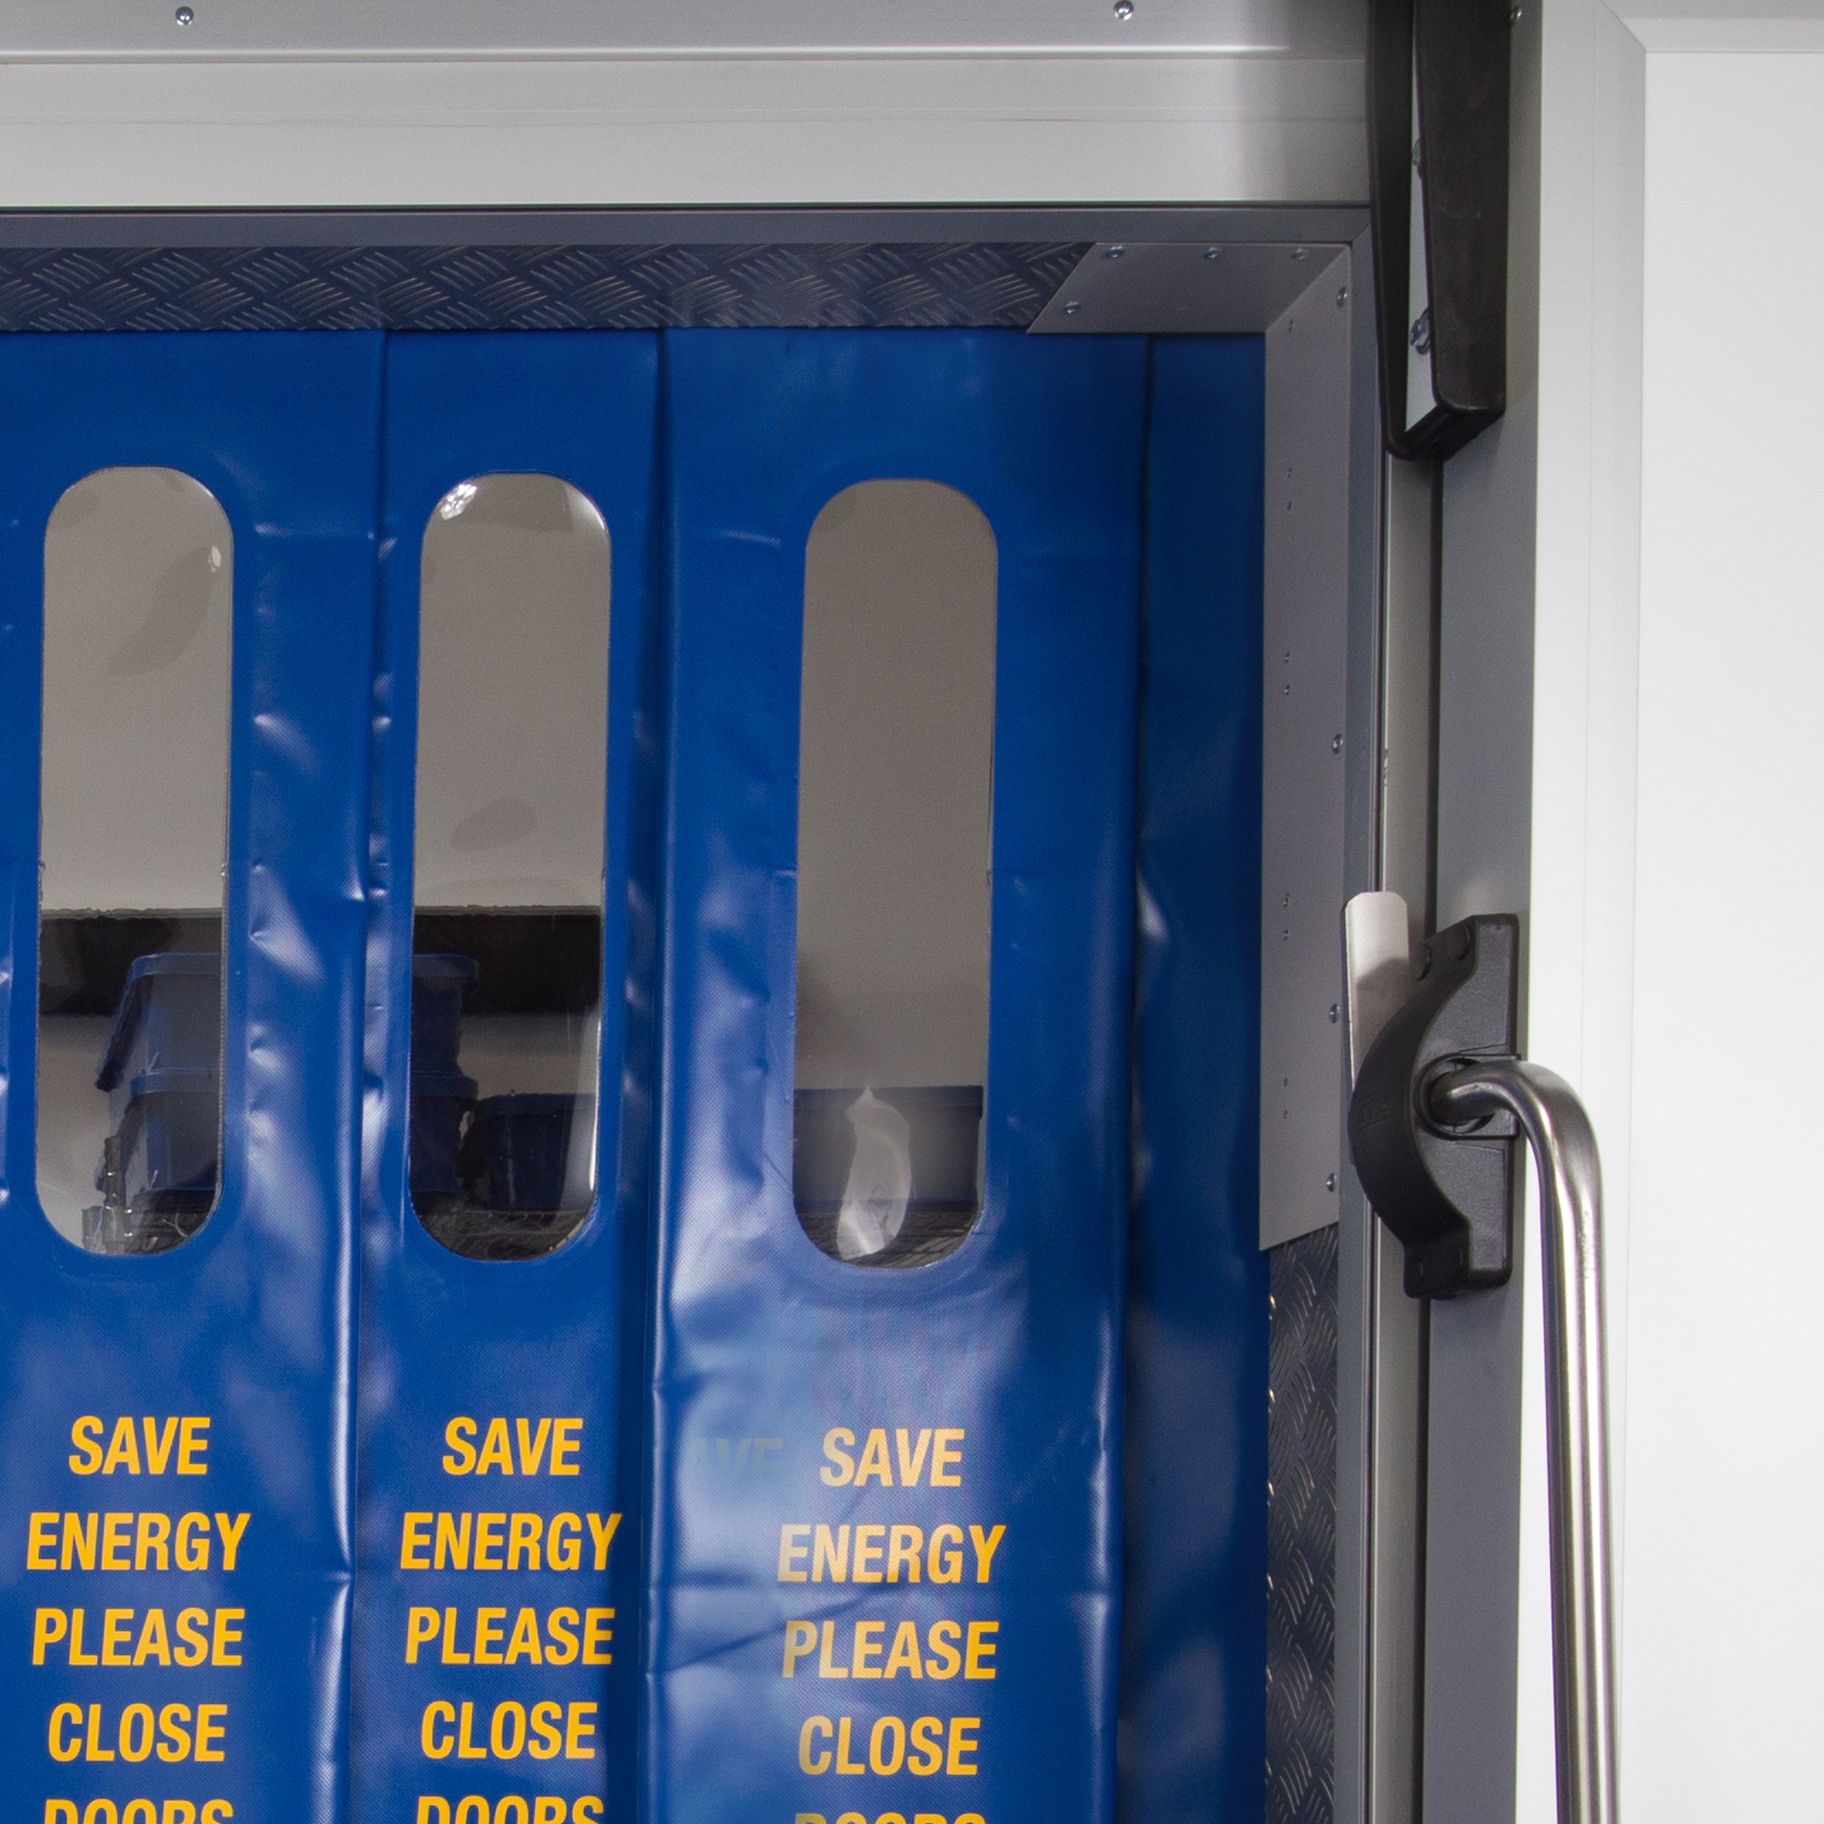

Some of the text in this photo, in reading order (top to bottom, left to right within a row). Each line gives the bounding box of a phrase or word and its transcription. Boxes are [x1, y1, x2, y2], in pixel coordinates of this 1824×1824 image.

[69, 1416, 211, 1475] SAVE
[442, 1416, 583, 1476] SAVE
[820, 1428, 965, 1487] SAVE
[26, 1512, 251, 1572] ENERGY
[400, 1512, 622, 1571] ENERGY
[777, 1524, 1006, 1584] ENERGY
[32, 1607, 245, 1667] PLEASE
[405, 1606, 616, 1666] PLEASE
[782, 1620, 1000, 1680] PLEASE
[48, 1702, 228, 1763] CLOSE
[421, 1700, 598, 1760] CLOSE
[798, 1716, 981, 1777] CLOSE
